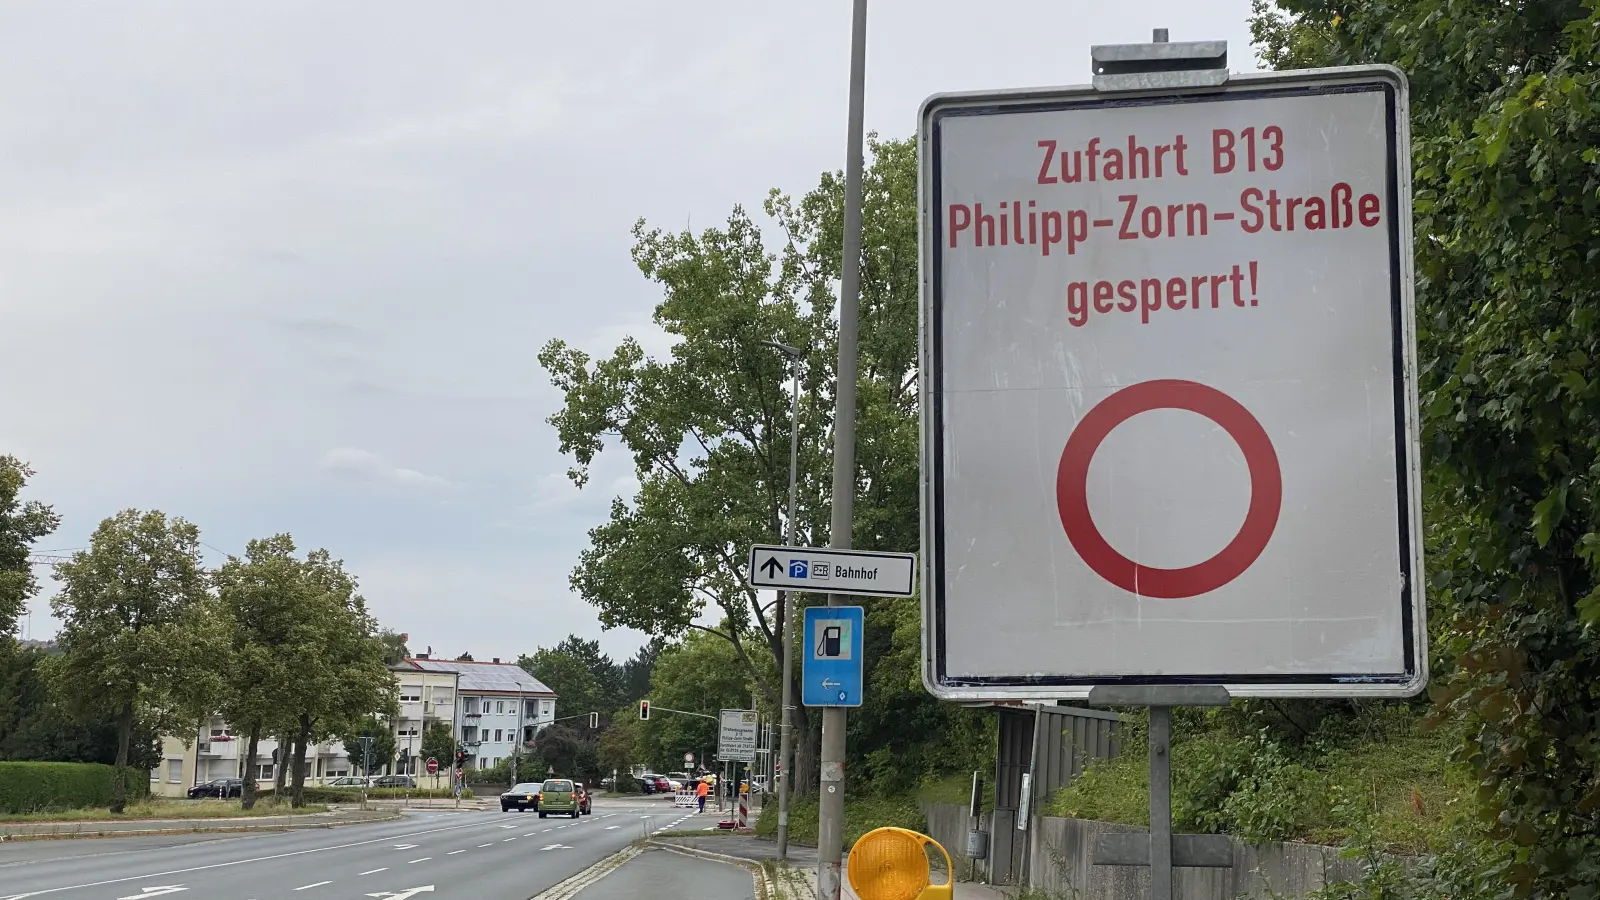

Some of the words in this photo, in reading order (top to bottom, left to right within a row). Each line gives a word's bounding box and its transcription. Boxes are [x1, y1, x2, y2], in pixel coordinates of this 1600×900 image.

[1038, 135, 1188, 184] Zufahrt
[1213, 125, 1284, 174] B13
[950, 183, 1381, 257] Philipp-Zorn-Straße
[1068, 261, 1257, 327] gesperrt!
[794, 565, 804, 578] P
[835, 565, 878, 580] Bahnhof
